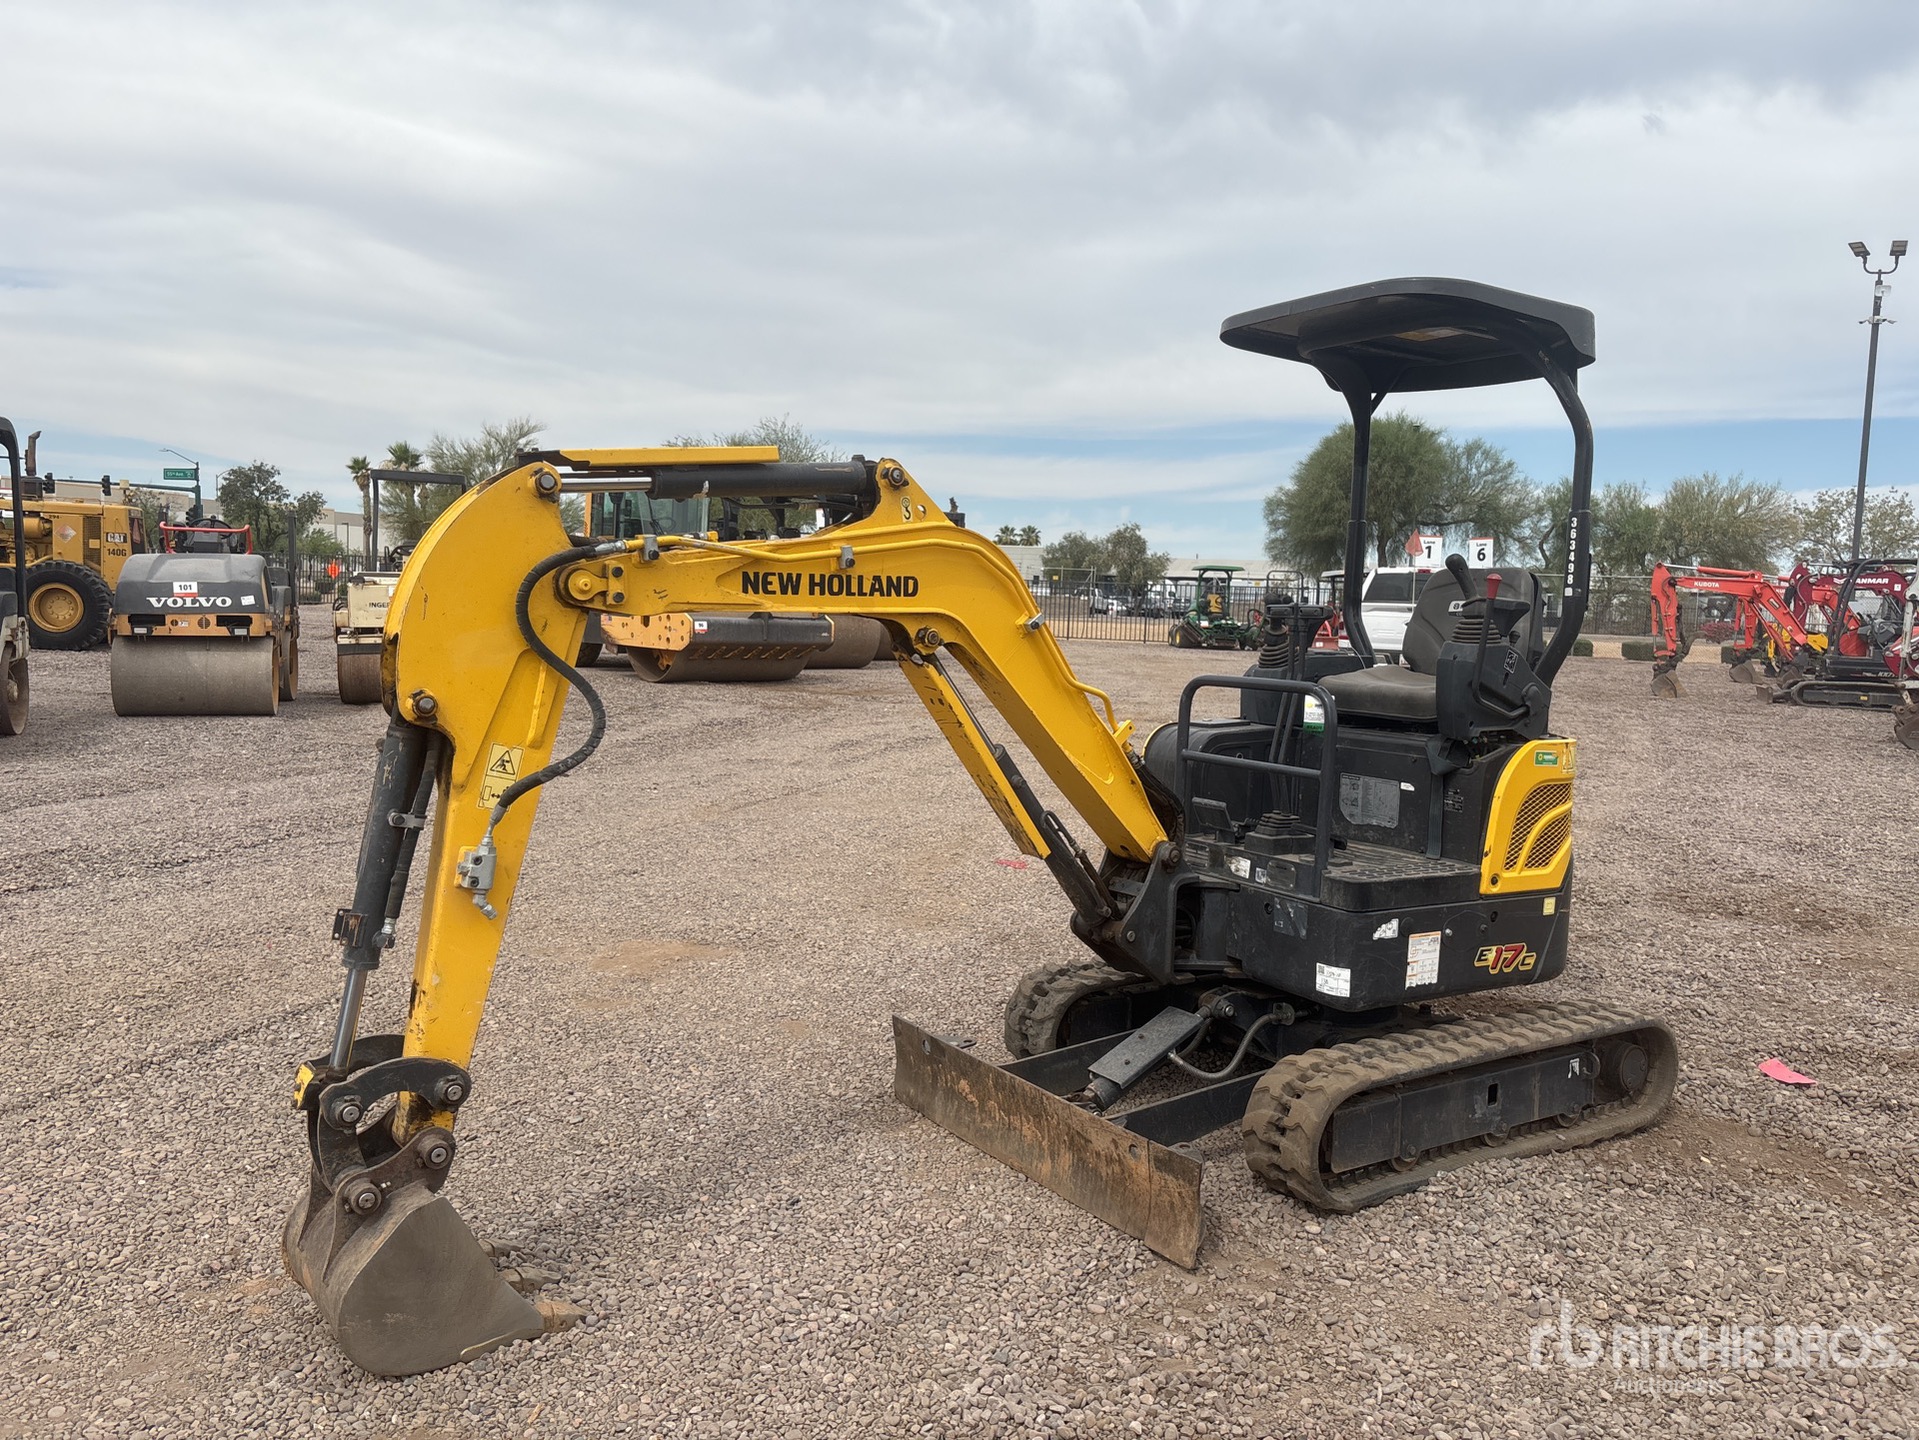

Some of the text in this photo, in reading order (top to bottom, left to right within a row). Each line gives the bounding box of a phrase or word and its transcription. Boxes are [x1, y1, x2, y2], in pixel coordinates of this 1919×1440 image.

[107, 533, 125, 543] CAT
[107, 548, 127, 556] 140G
[1425, 545, 1432, 559] 1
[1477, 547, 1486, 561] 6
[1567, 517, 1578, 585] 363498
[742, 571, 918, 597] NEW HOLLAND
[146, 596, 232, 608] VOLVO
